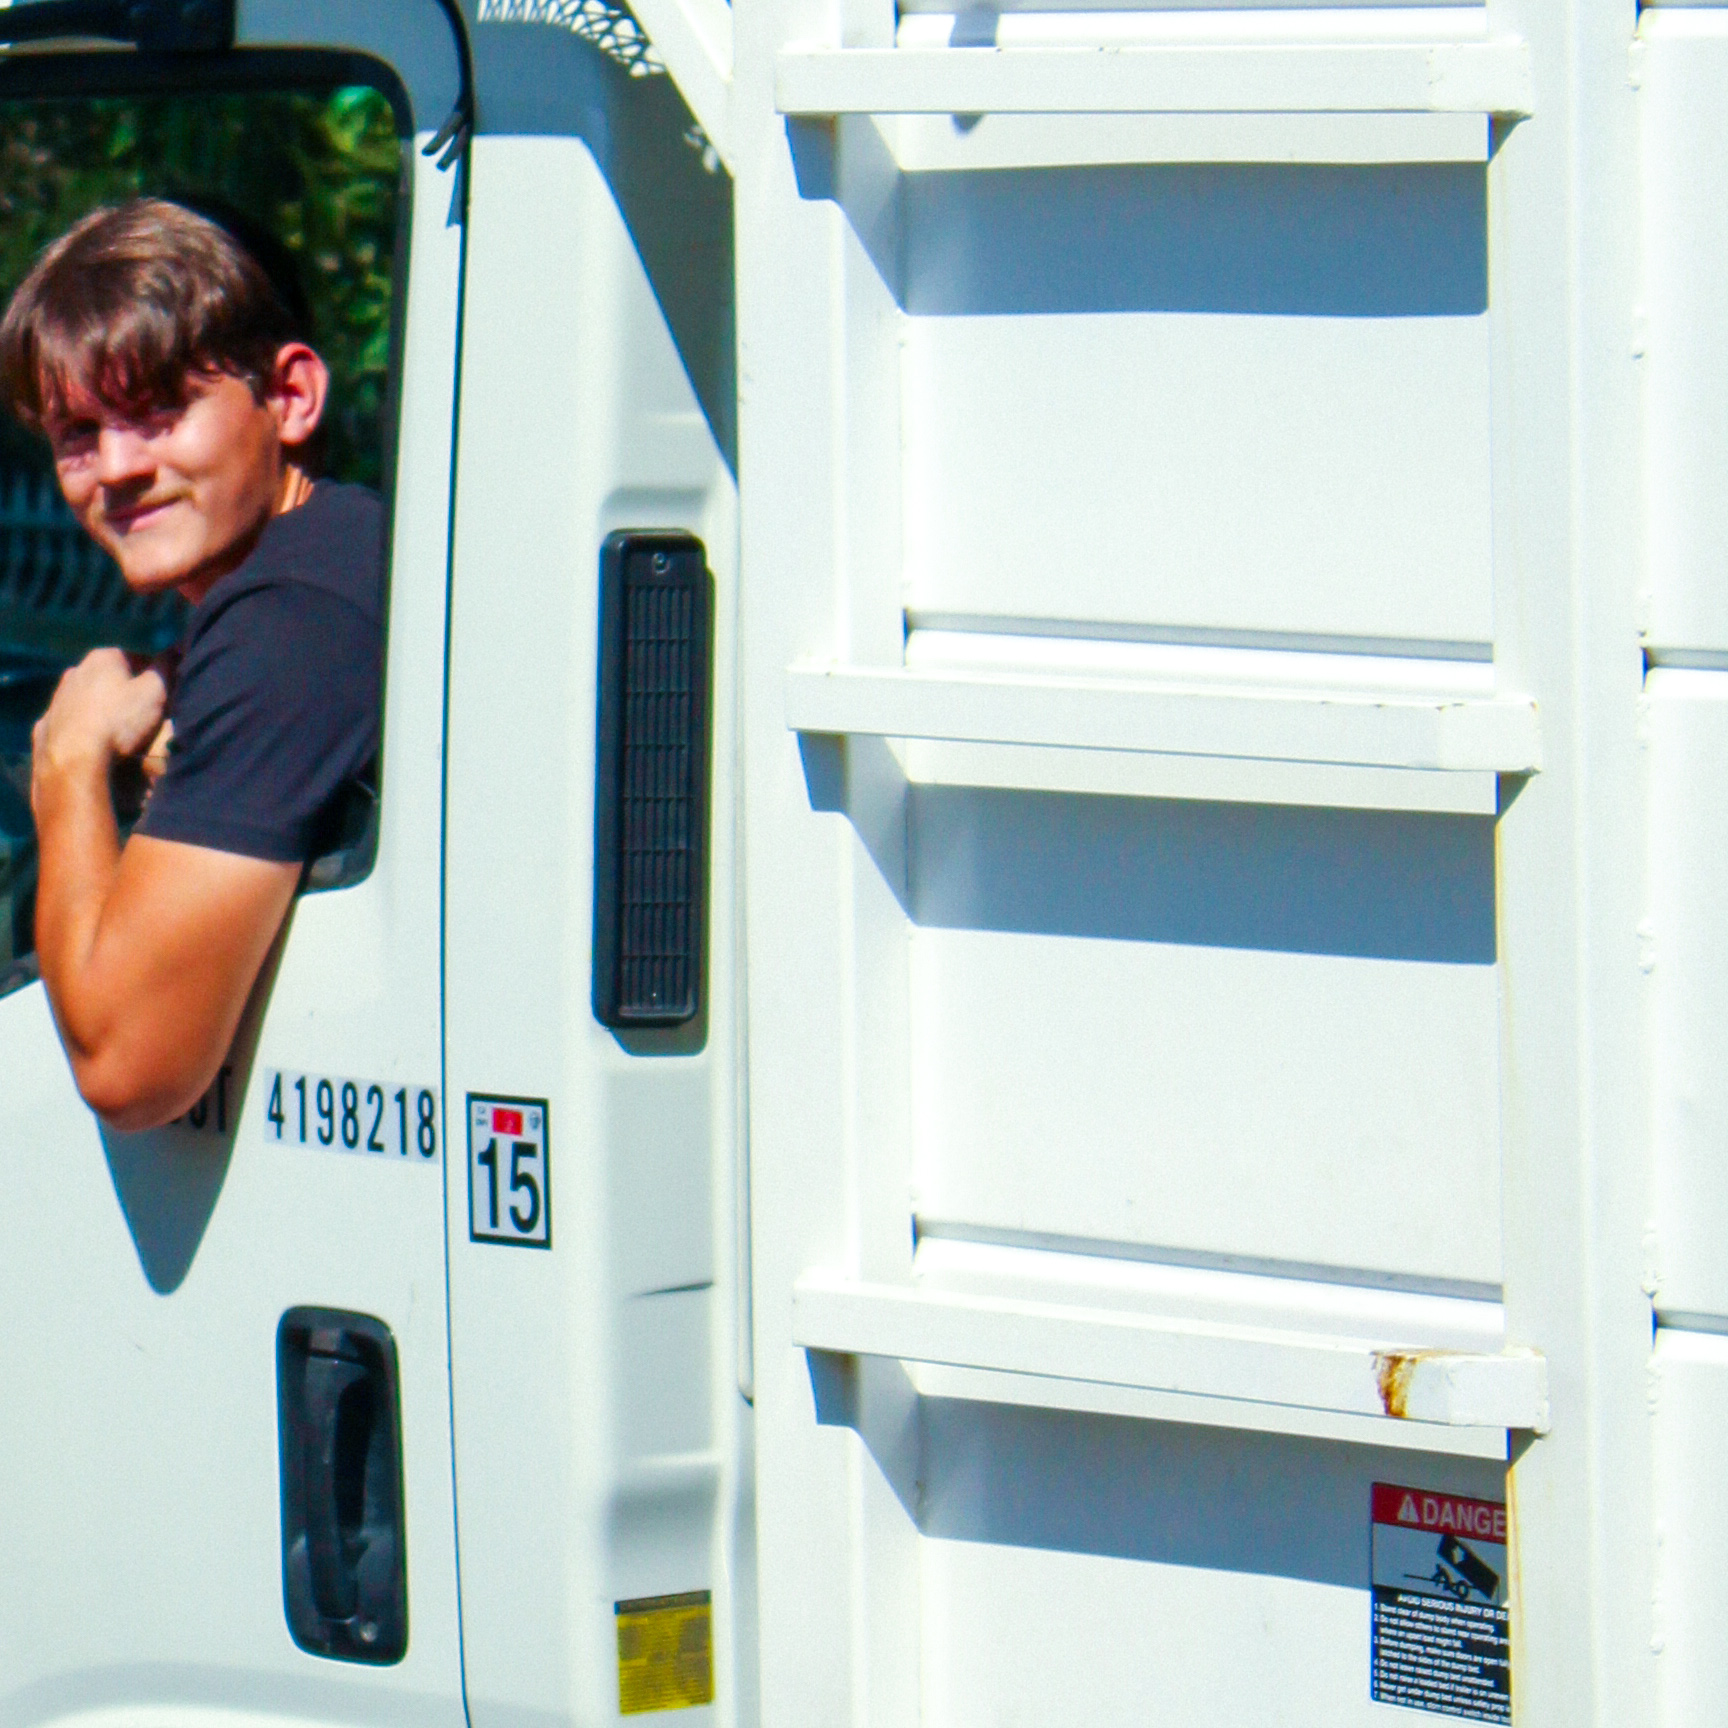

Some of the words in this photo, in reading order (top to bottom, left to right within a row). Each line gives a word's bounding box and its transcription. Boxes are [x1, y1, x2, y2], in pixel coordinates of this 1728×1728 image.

[267, 1072, 437, 1158] 4198218
[478, 1137, 541, 1233] 15
[1423, 1498, 1506, 1538] DANGE
